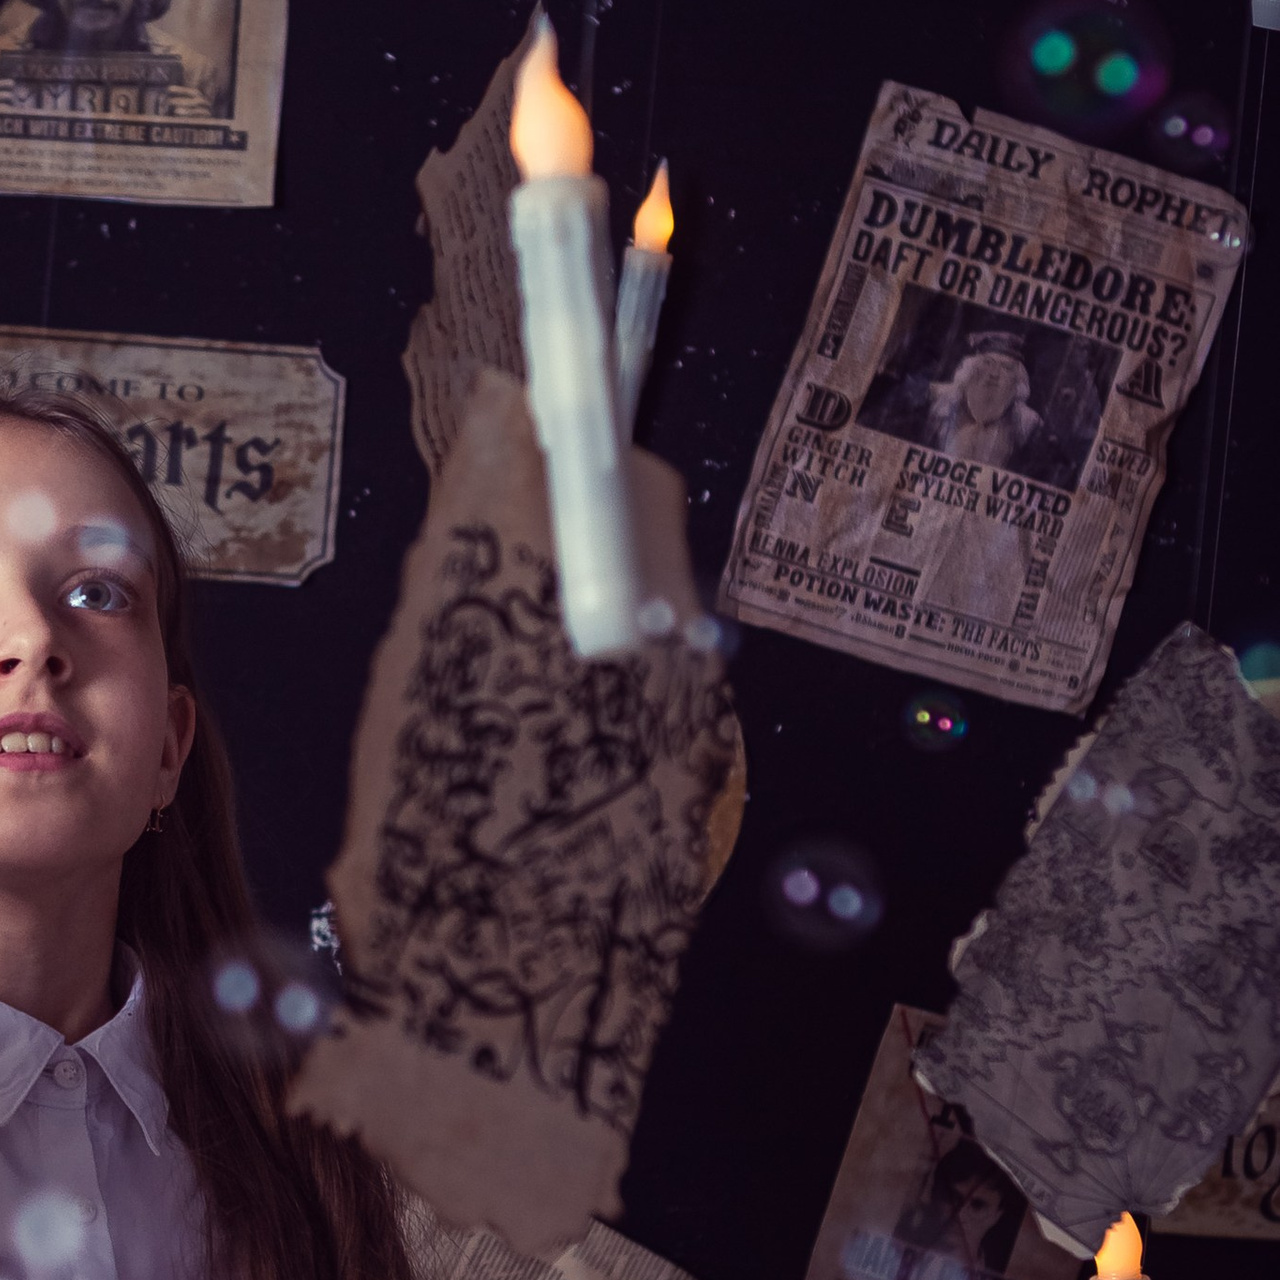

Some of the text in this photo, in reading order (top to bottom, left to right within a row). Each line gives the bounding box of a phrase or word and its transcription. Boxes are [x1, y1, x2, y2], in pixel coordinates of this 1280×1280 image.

[927, 118, 1056, 179] DAILY
[1083, 168, 1241, 242] ROPHET
[864, 190, 1197, 333] DUMBLEDORE:
[853, 229, 1188, 366] DAFT OR DANGEROUS?
[157, 382, 206, 405] TO
[126, 418, 282, 513] arts
[782, 443, 869, 488] WITCH
[787, 425, 873, 469] GINGER
[903, 447, 1072, 517] FUDGE VOTED
[1096, 443, 1151, 477] SAVED
[897, 470, 1064, 540] STYLISH WIZARD
[750, 530, 919, 597] HENNA EXPLOSION
[774, 564, 859, 605] POTION
[863, 588, 946, 632] WASTE:
[951, 616, 983, 645] THE
[989, 627, 1043, 661] FACTS
